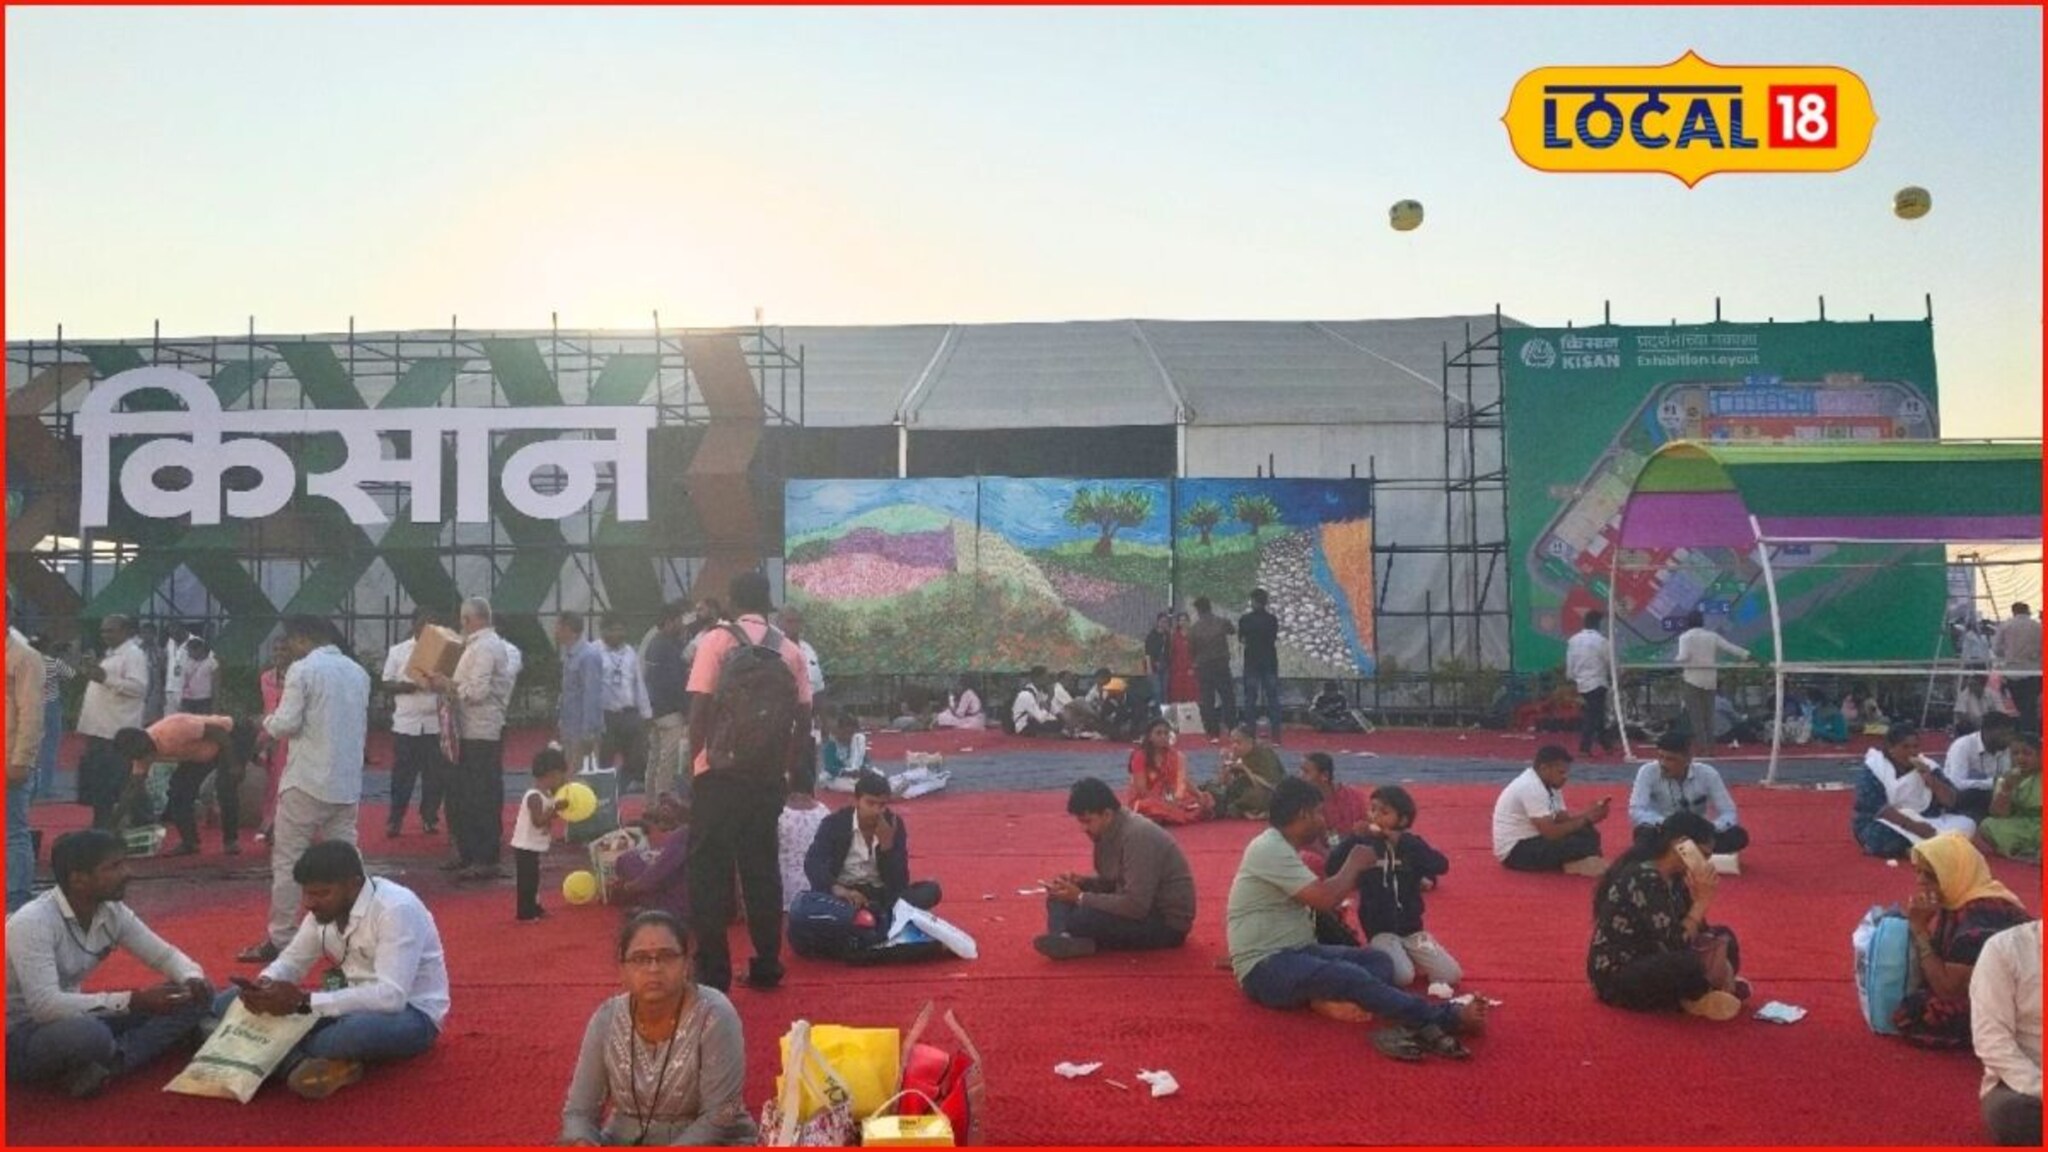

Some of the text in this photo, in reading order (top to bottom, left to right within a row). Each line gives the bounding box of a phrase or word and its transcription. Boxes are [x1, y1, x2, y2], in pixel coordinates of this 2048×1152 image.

[1562, 353, 1621, 369] KISAN
[1637, 353, 1760, 369] Exhibition Layout
[73, 366, 657, 527] किसान
